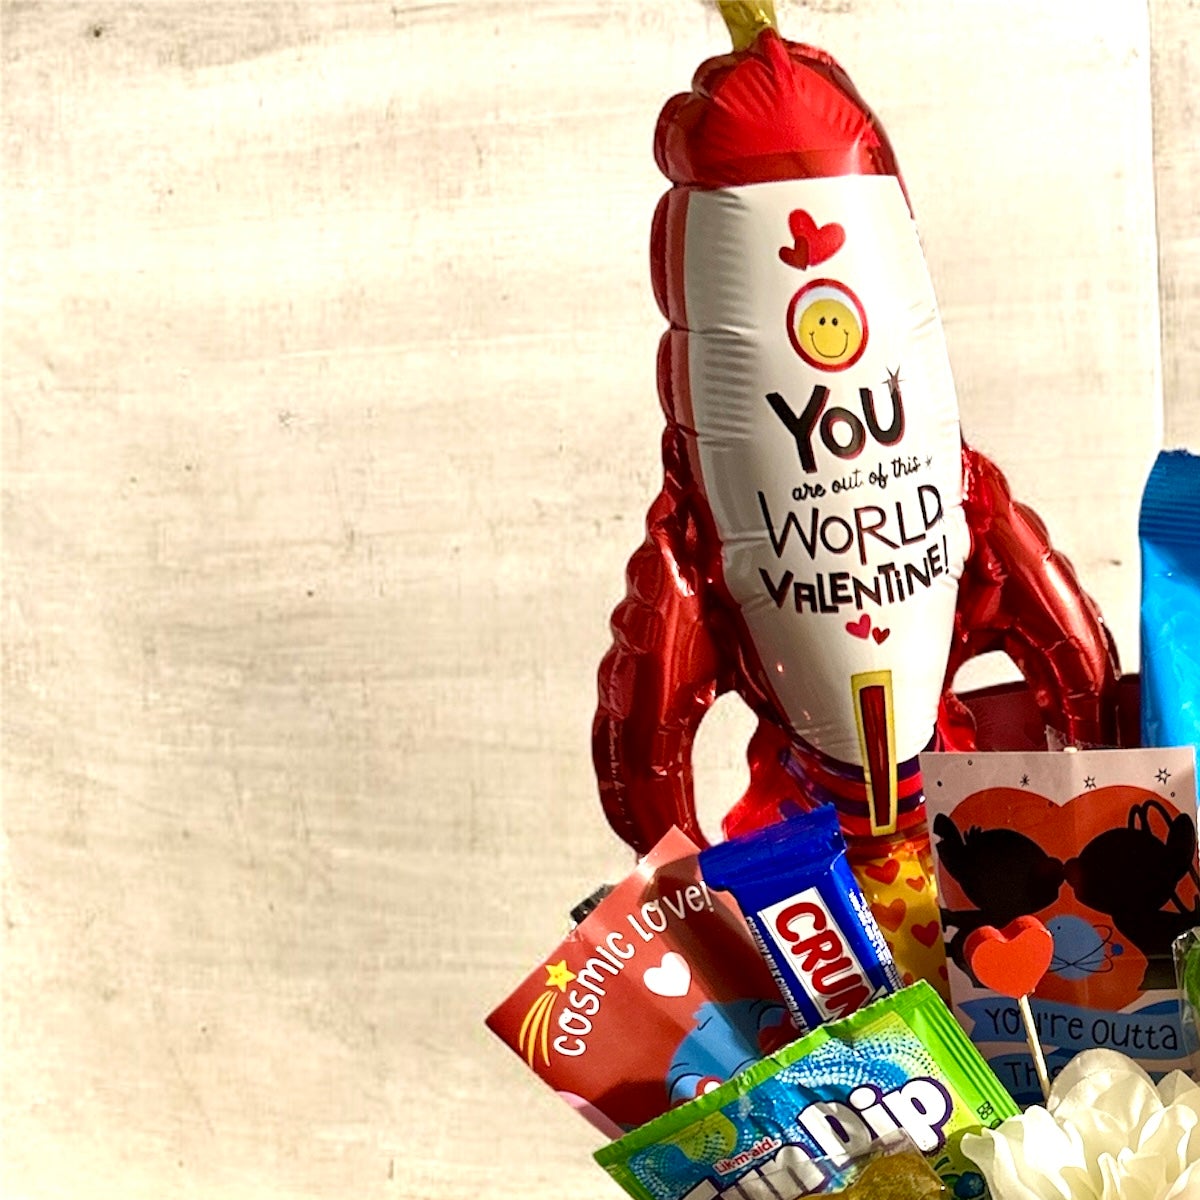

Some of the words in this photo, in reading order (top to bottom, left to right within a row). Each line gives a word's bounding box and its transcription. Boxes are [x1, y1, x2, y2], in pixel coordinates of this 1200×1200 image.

[766, 384, 905, 473] YOU
[792, 483, 825, 501] are
[832, 469, 863, 493] out
[869, 463, 888, 489] of
[893, 456, 920, 478] this
[758, 484, 943, 565] WORLD
[797, 1077, 950, 1166] Dip
